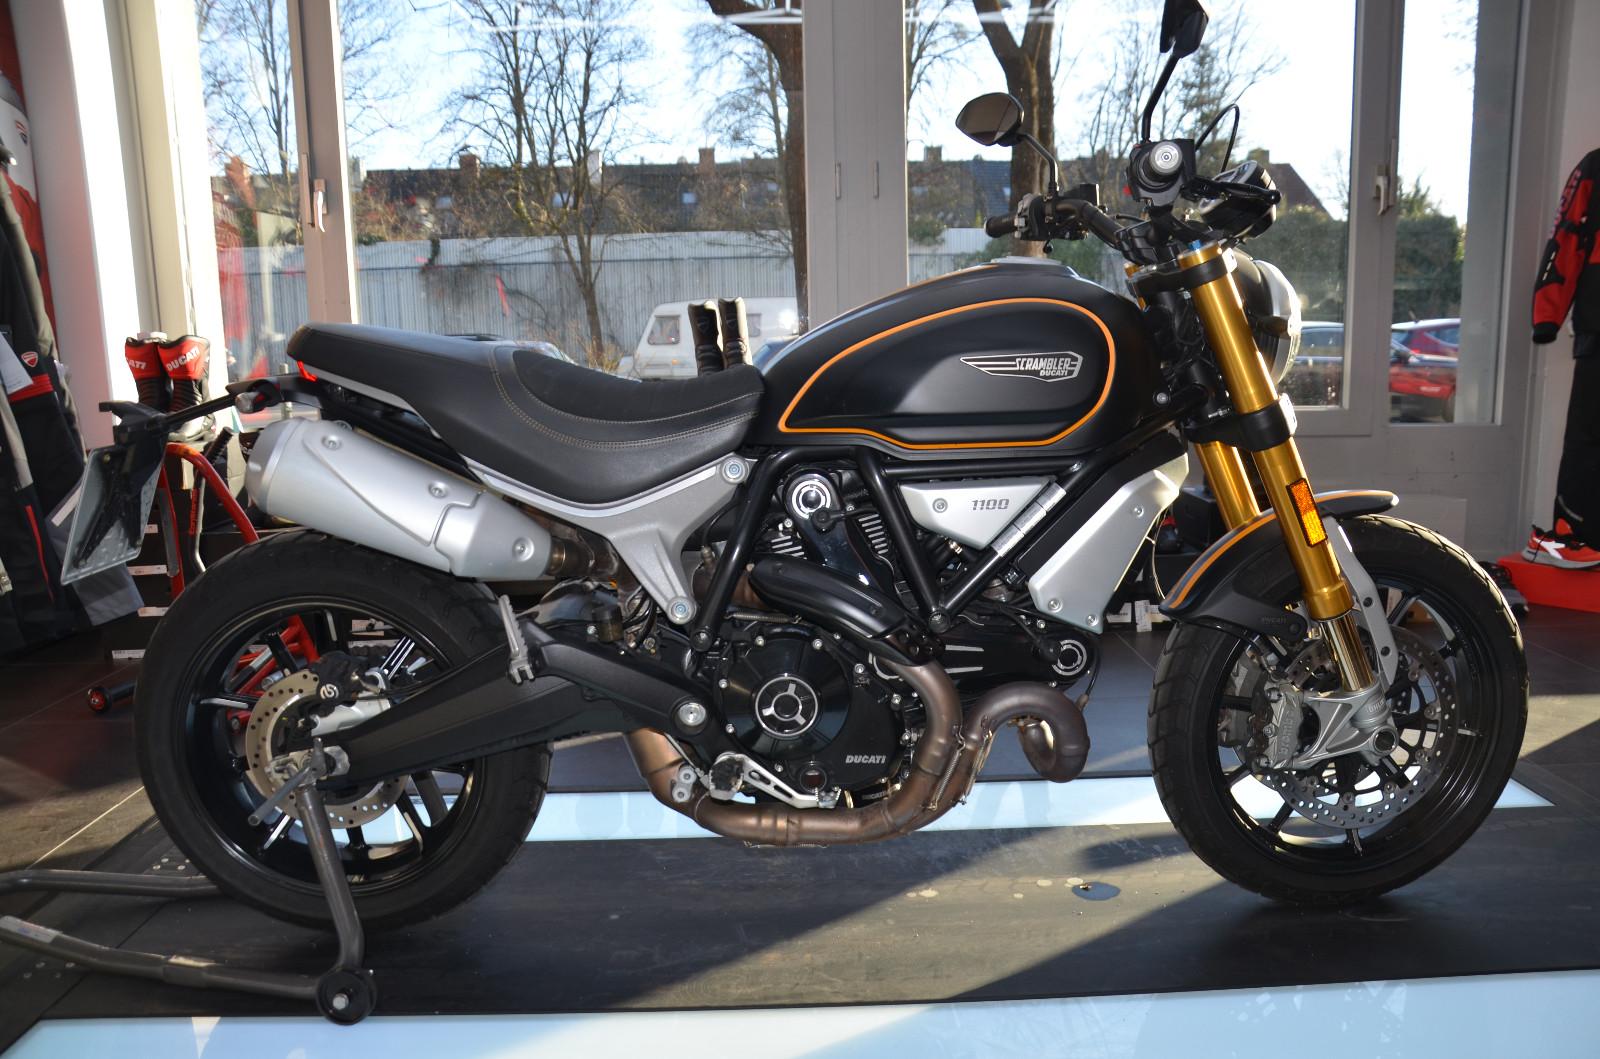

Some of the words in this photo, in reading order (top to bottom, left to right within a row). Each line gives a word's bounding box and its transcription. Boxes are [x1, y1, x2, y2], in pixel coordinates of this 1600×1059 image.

[128, 359, 146, 370] ATI
[166, 346, 200, 371] DUCATI
[1015, 357, 1072, 371] SCRAMBLER
[1039, 369, 1069, 377] DUCATI
[971, 498, 1010, 511] 1100
[845, 754, 887, 764] DUCATI
